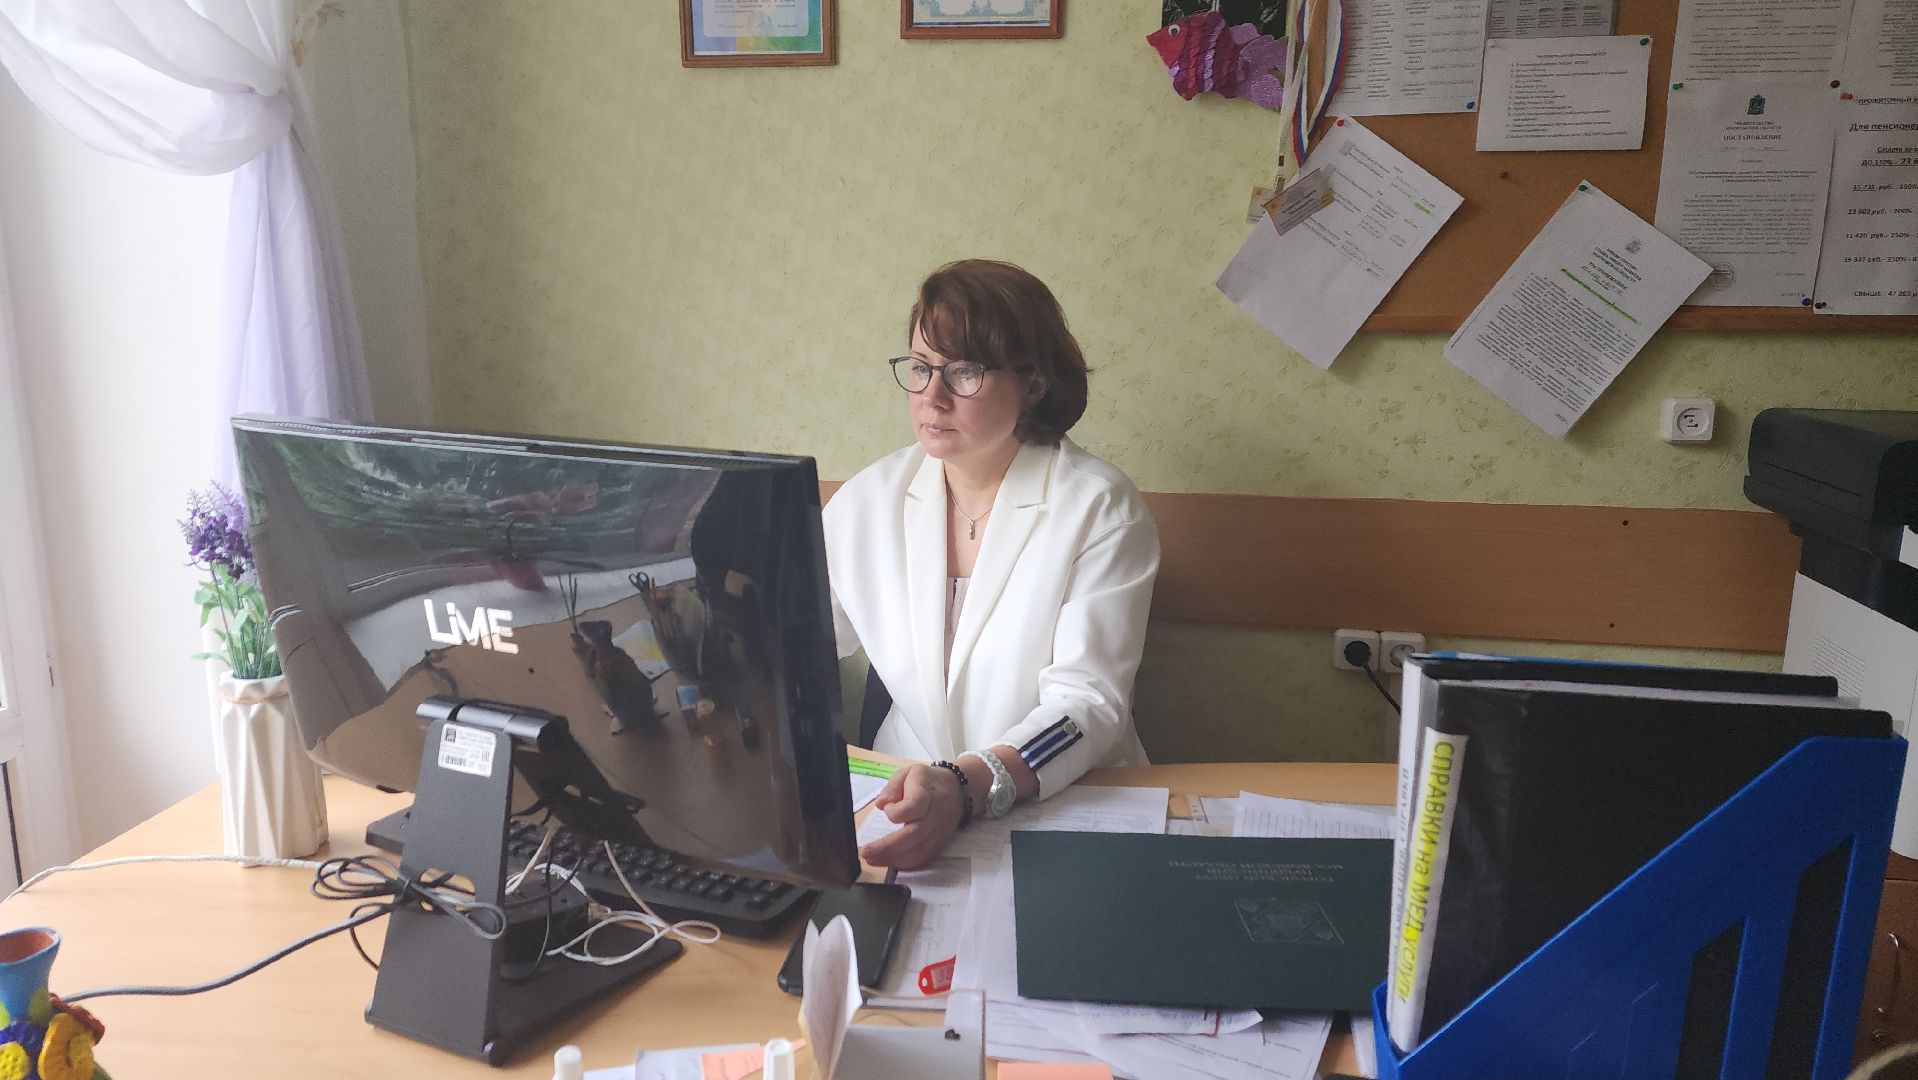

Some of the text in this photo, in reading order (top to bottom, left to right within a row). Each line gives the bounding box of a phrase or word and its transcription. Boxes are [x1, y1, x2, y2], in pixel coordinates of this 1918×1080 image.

[1849, 122, 1869, 132] Для
[1420, 741, 1454, 845] СПРАВКИ
[1405, 883, 1430, 932] МЕД
